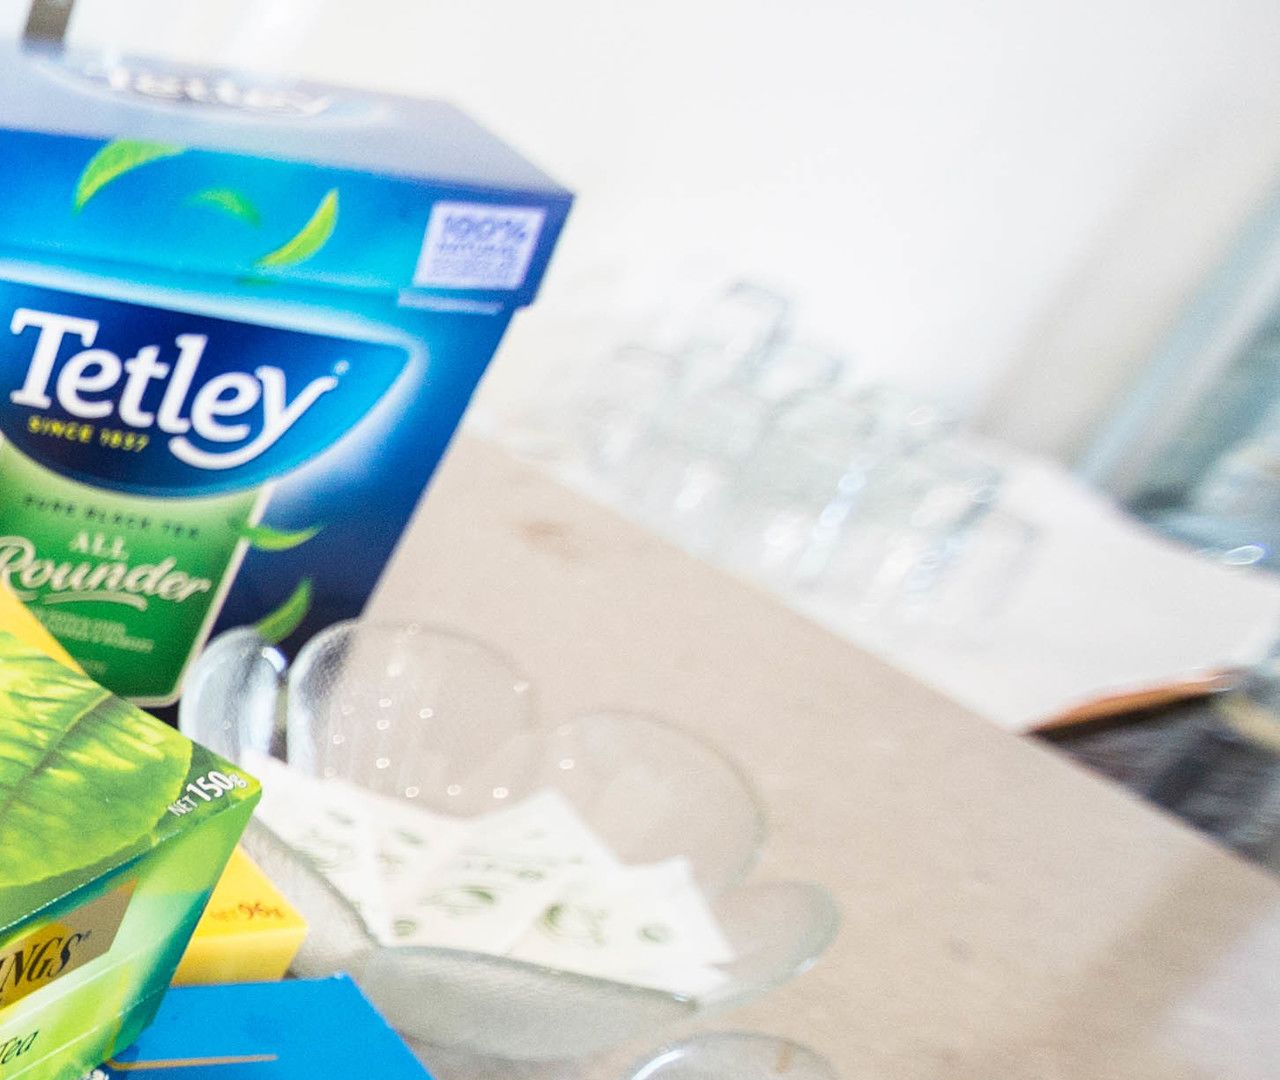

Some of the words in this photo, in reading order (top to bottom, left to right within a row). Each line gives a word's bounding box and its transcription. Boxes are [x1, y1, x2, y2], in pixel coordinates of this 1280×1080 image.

[9, 306, 340, 471] Tetley
[68, 531, 131, 561] ALL
[166, 795, 200, 818] NET
[185, 769, 250, 802] 150g
